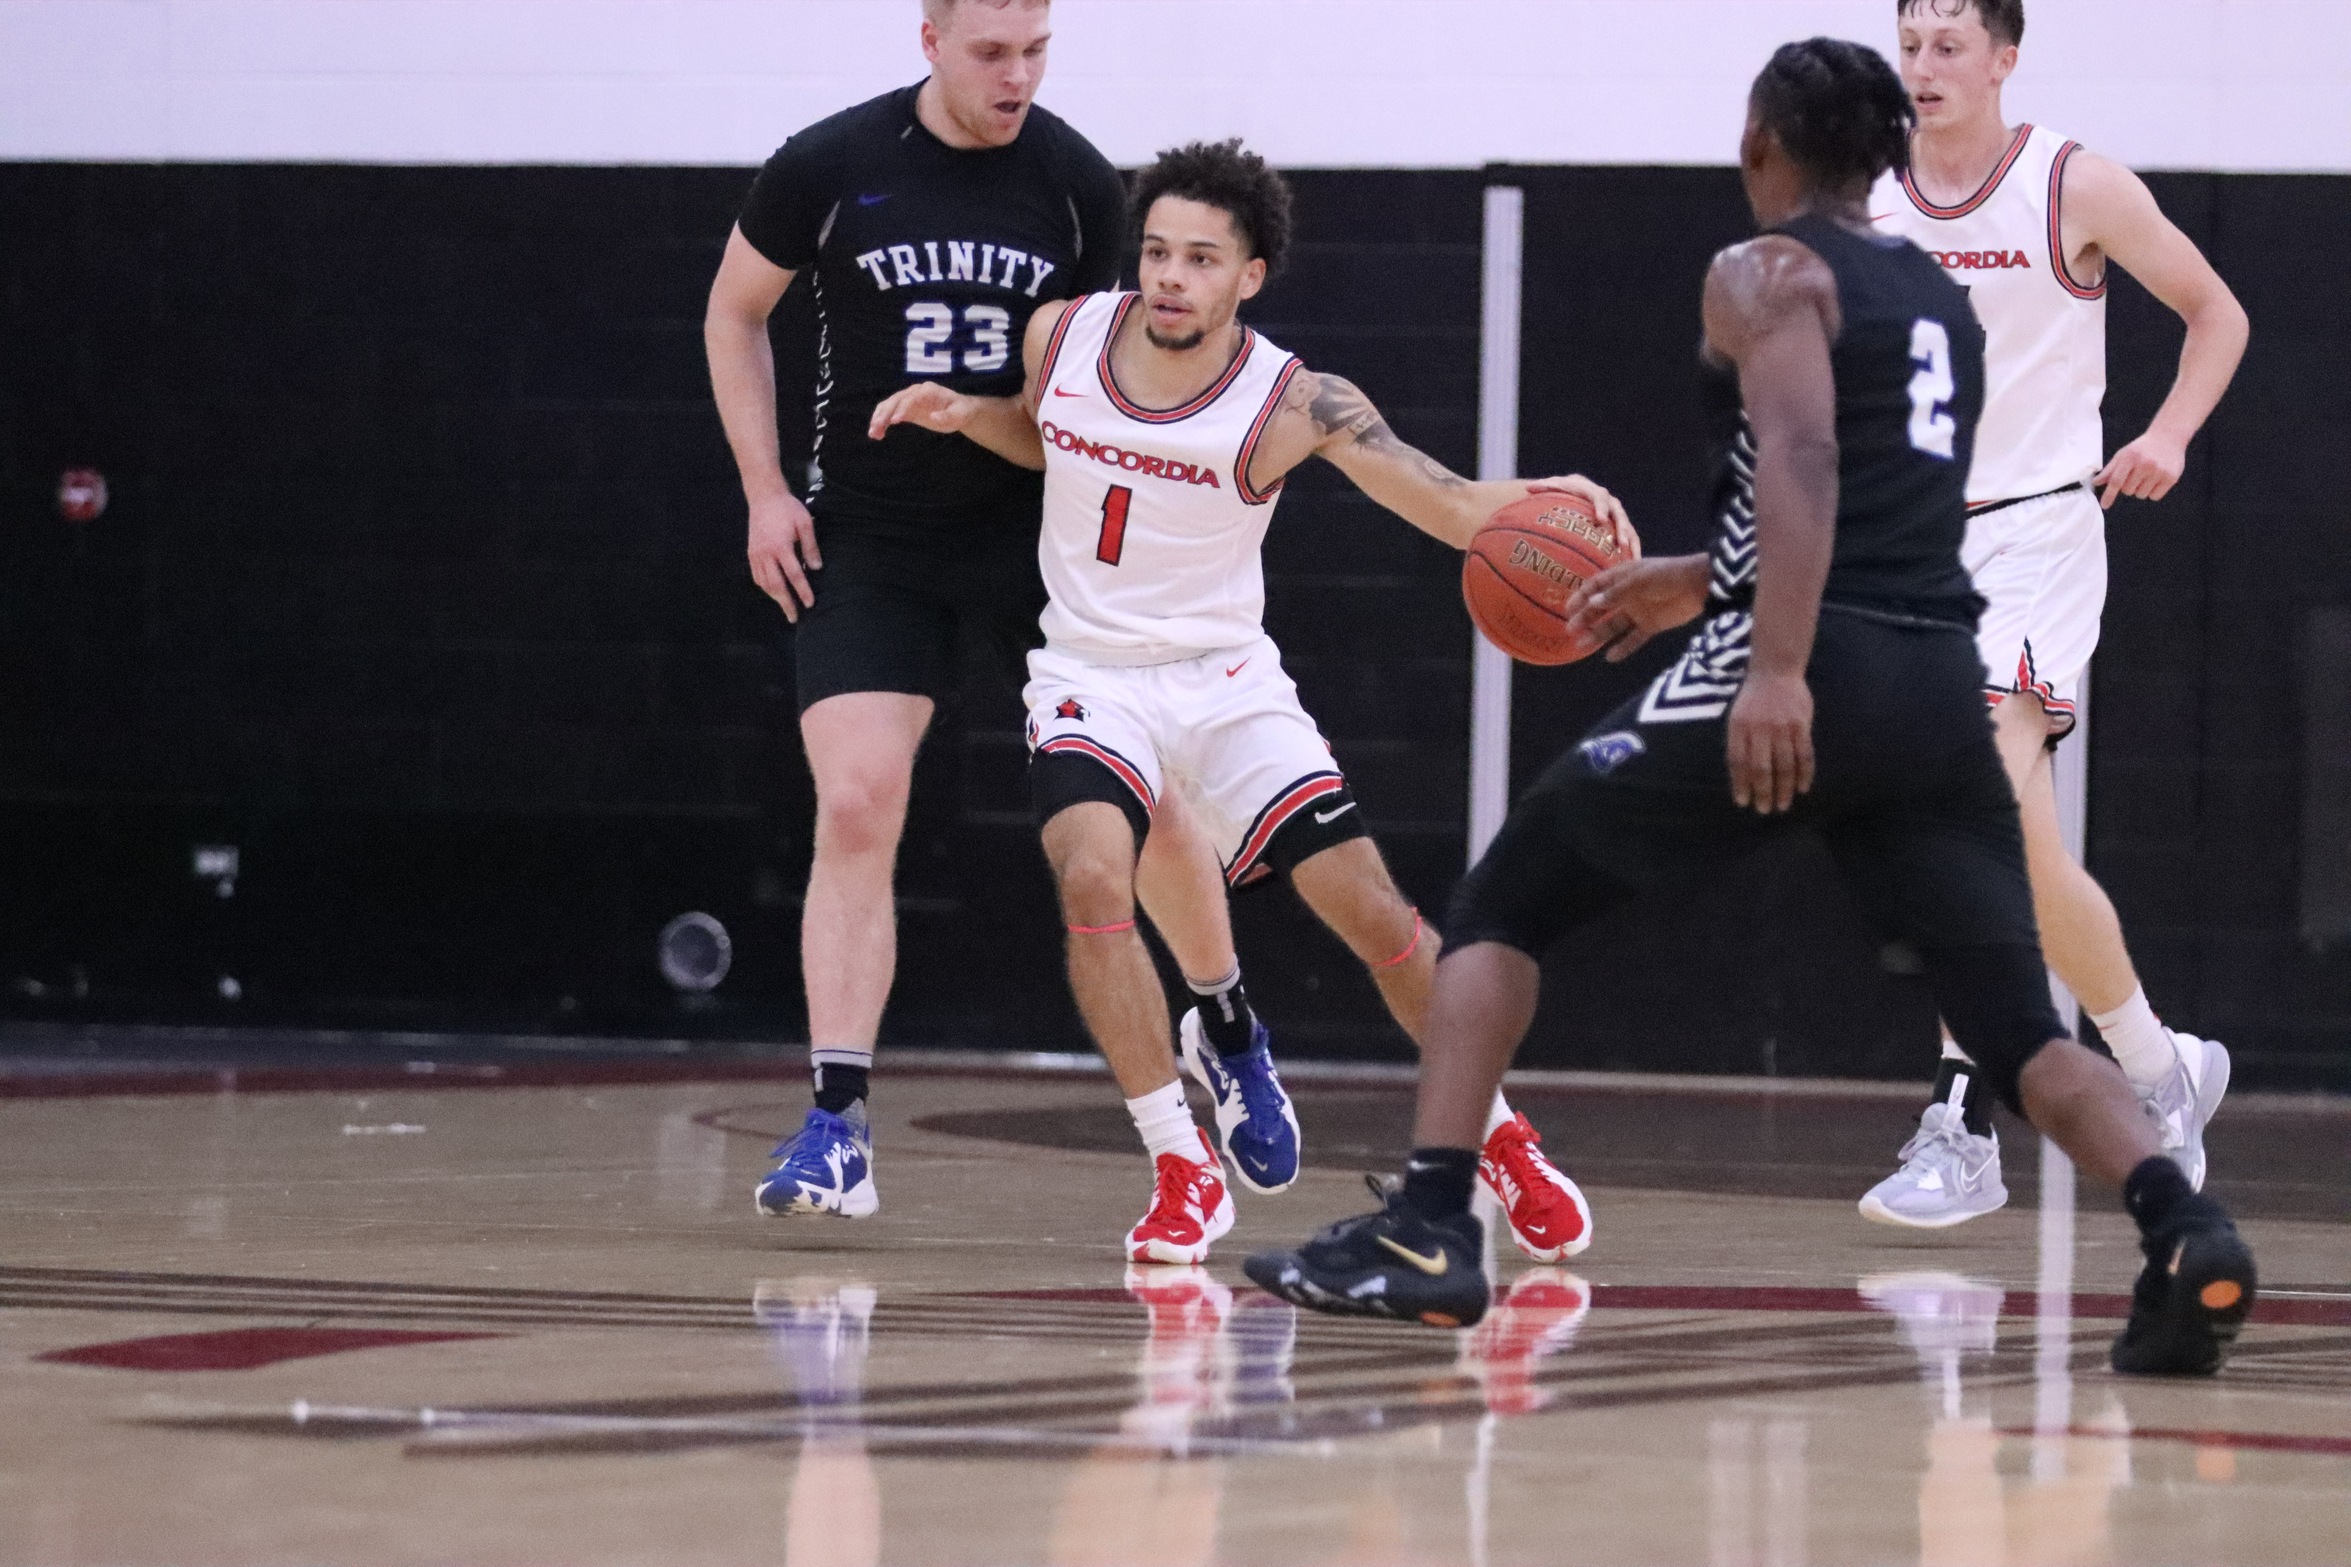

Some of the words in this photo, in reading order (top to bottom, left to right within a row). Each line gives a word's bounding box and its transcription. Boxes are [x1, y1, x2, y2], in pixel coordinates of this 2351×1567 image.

[856, 241, 1054, 297] TRINITY
[1926, 250, 2031, 269] ORDIA
[905, 302, 1009, 373] 23
[1907, 318, 1956, 460] 2
[1041, 420, 1220, 489] CONCORDIA
[1096, 483, 1133, 567] 1
[1537, 512, 1616, 559] EGACY
